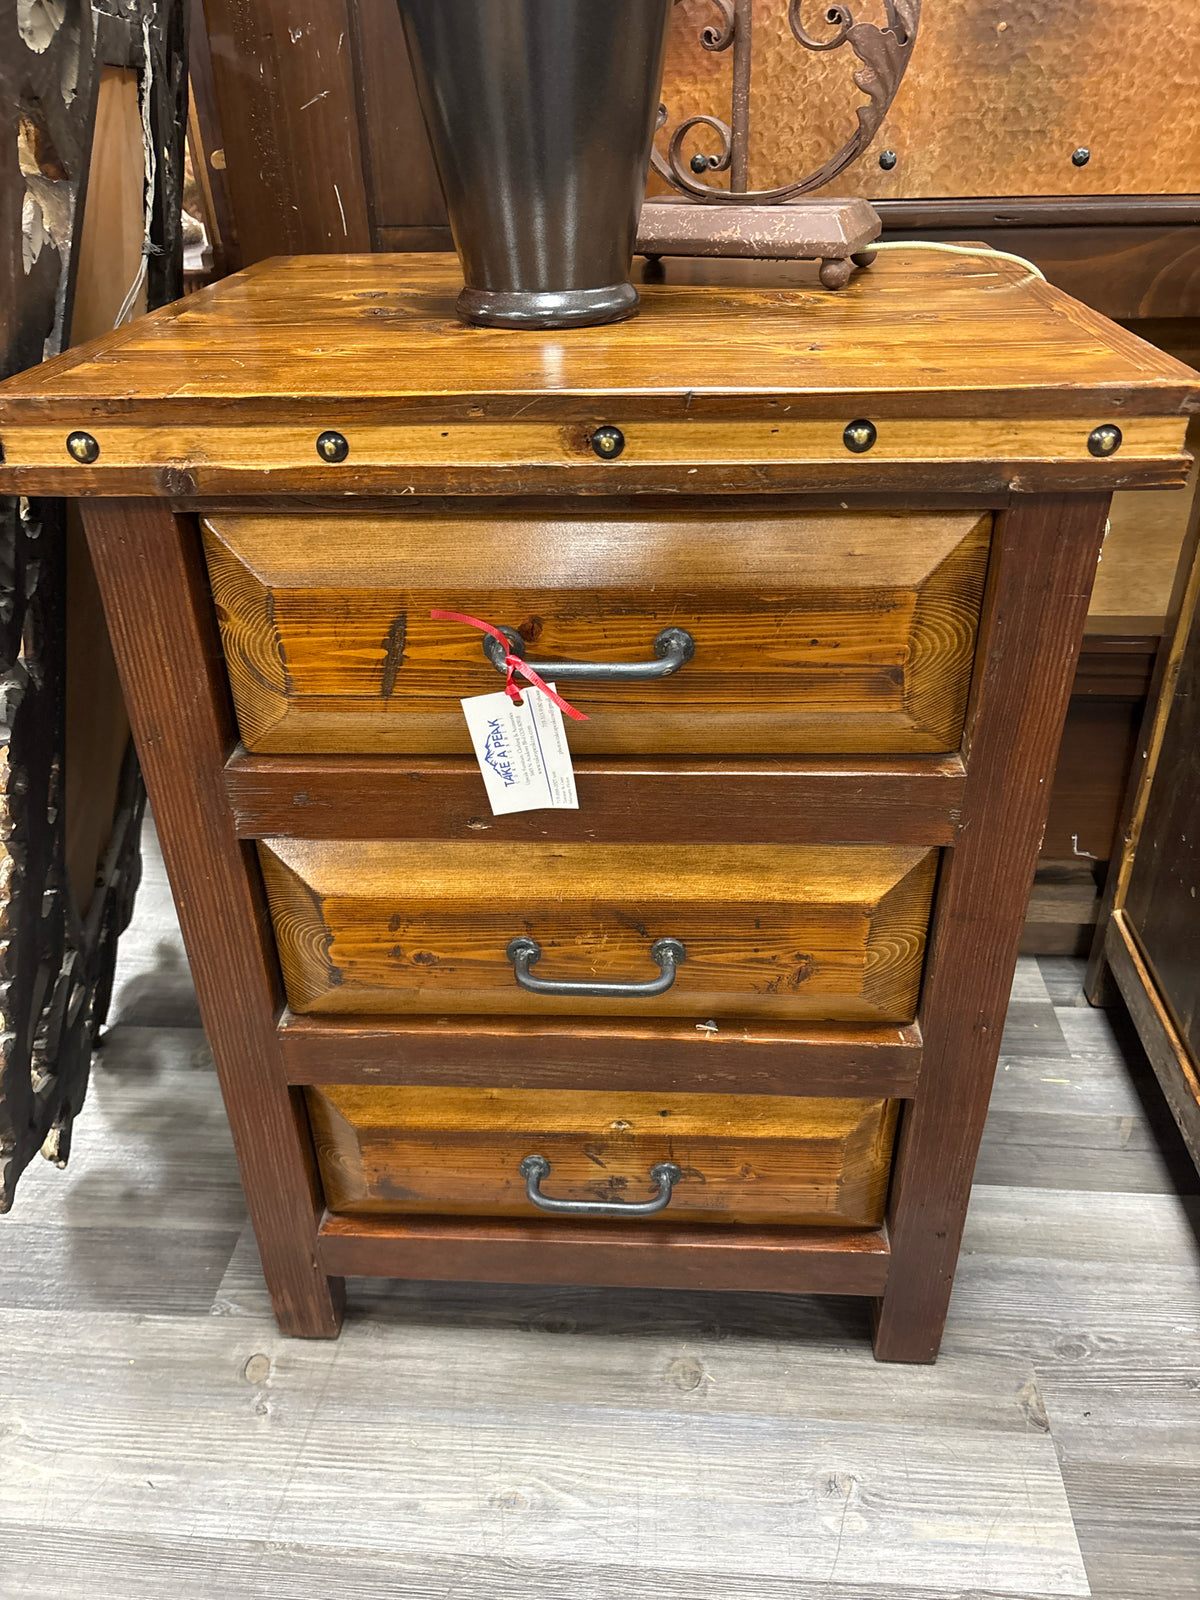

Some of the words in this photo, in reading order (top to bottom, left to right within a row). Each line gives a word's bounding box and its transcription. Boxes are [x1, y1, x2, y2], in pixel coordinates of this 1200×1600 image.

[487, 718, 505, 748] PEAK
[496, 750, 508, 758] A
[499, 761, 515, 787] TAKE
